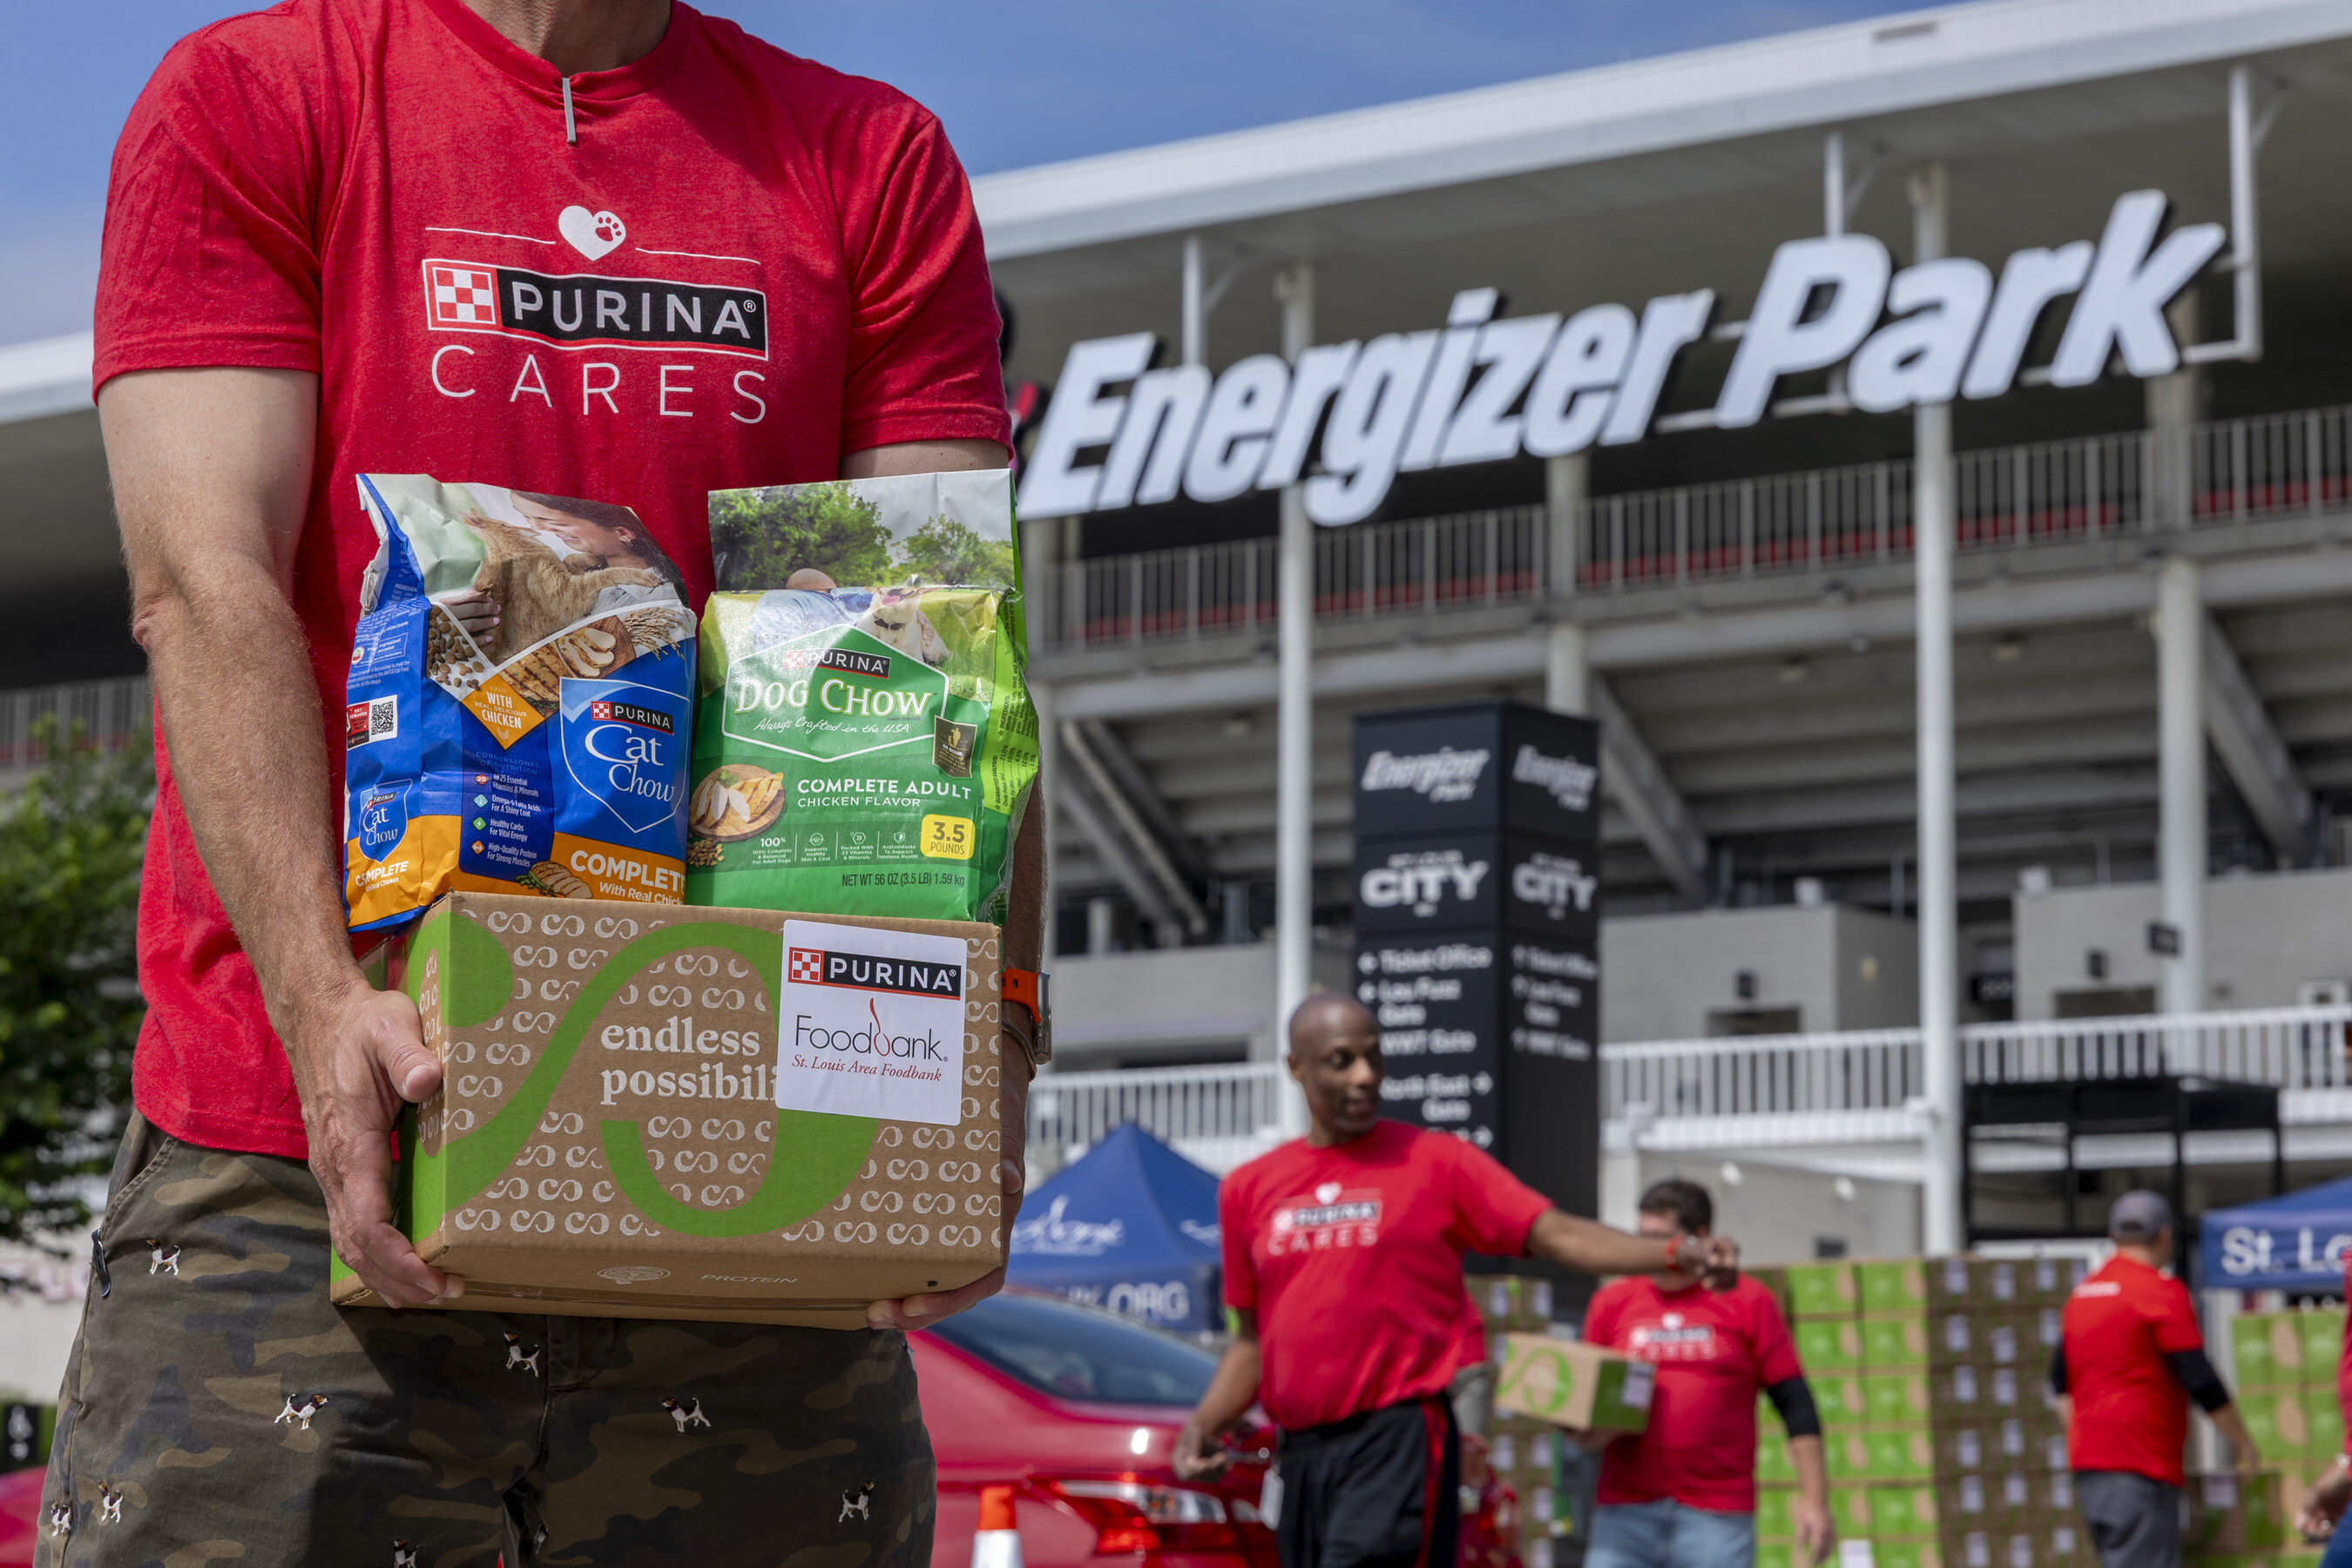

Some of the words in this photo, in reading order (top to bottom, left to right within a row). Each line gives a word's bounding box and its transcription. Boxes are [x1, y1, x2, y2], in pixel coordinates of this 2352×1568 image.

[1016, 288, 1716, 526] Energizer
[1715, 190, 2226, 427] Park
[430, 345, 767, 424] CARES
[486, 691, 513, 709] WITH
[481, 709, 522, 729] CHICKEN
[614, 705, 671, 729] PURINA
[754, 717, 792, 733] Always
[794, 716, 843, 733] Crafted
[841, 724, 858, 733] in
[862, 721, 880, 733] the
[882, 723, 910, 733] USA
[585, 724, 664, 766] Cat
[518, 787, 539, 797] Minerals
[608, 763, 674, 801] Chow
[797, 778, 898, 794] COMPLETE
[905, 780, 971, 800] ADULT
[505, 805, 519, 817] Shiny
[519, 808, 531, 818] Coat
[797, 796, 860, 808] CHICKEN
[865, 797, 921, 807] FLAVOR
[362, 807, 389, 832] Cat
[490, 818, 510, 829] Healthy
[510, 821, 524, 832] Carbs
[366, 825, 398, 846] Chow
[498, 828, 510, 838] Vital
[510, 832, 528, 842] Energy
[932, 821, 965, 842] 3.5
[486, 851, 496, 860] For
[519, 848, 537, 859] Protein
[930, 841, 965, 855] POUNDS
[841, 875, 858, 887] NET
[859, 874, 874, 886] WT
[874, 874, 885, 886] 56
[887, 873, 899, 885] OZ
[900, 873, 916, 887] (3.5
[917, 873, 932, 885] LB)
[934, 873, 953, 885] 1.59
[954, 875, 965, 887] kg
[1360, 861, 1490, 907] CITY
[599, 881, 625, 897] With
[627, 888, 652, 902] Real
[600, 1015, 760, 1057] endless
[792, 1054, 808, 1068] St.
[811, 1056, 845, 1072] Louis
[847, 1062, 877, 1075] Area
[880, 1063, 943, 1081] Foodbank
[700, 1274, 799, 1284] PROTEIN
